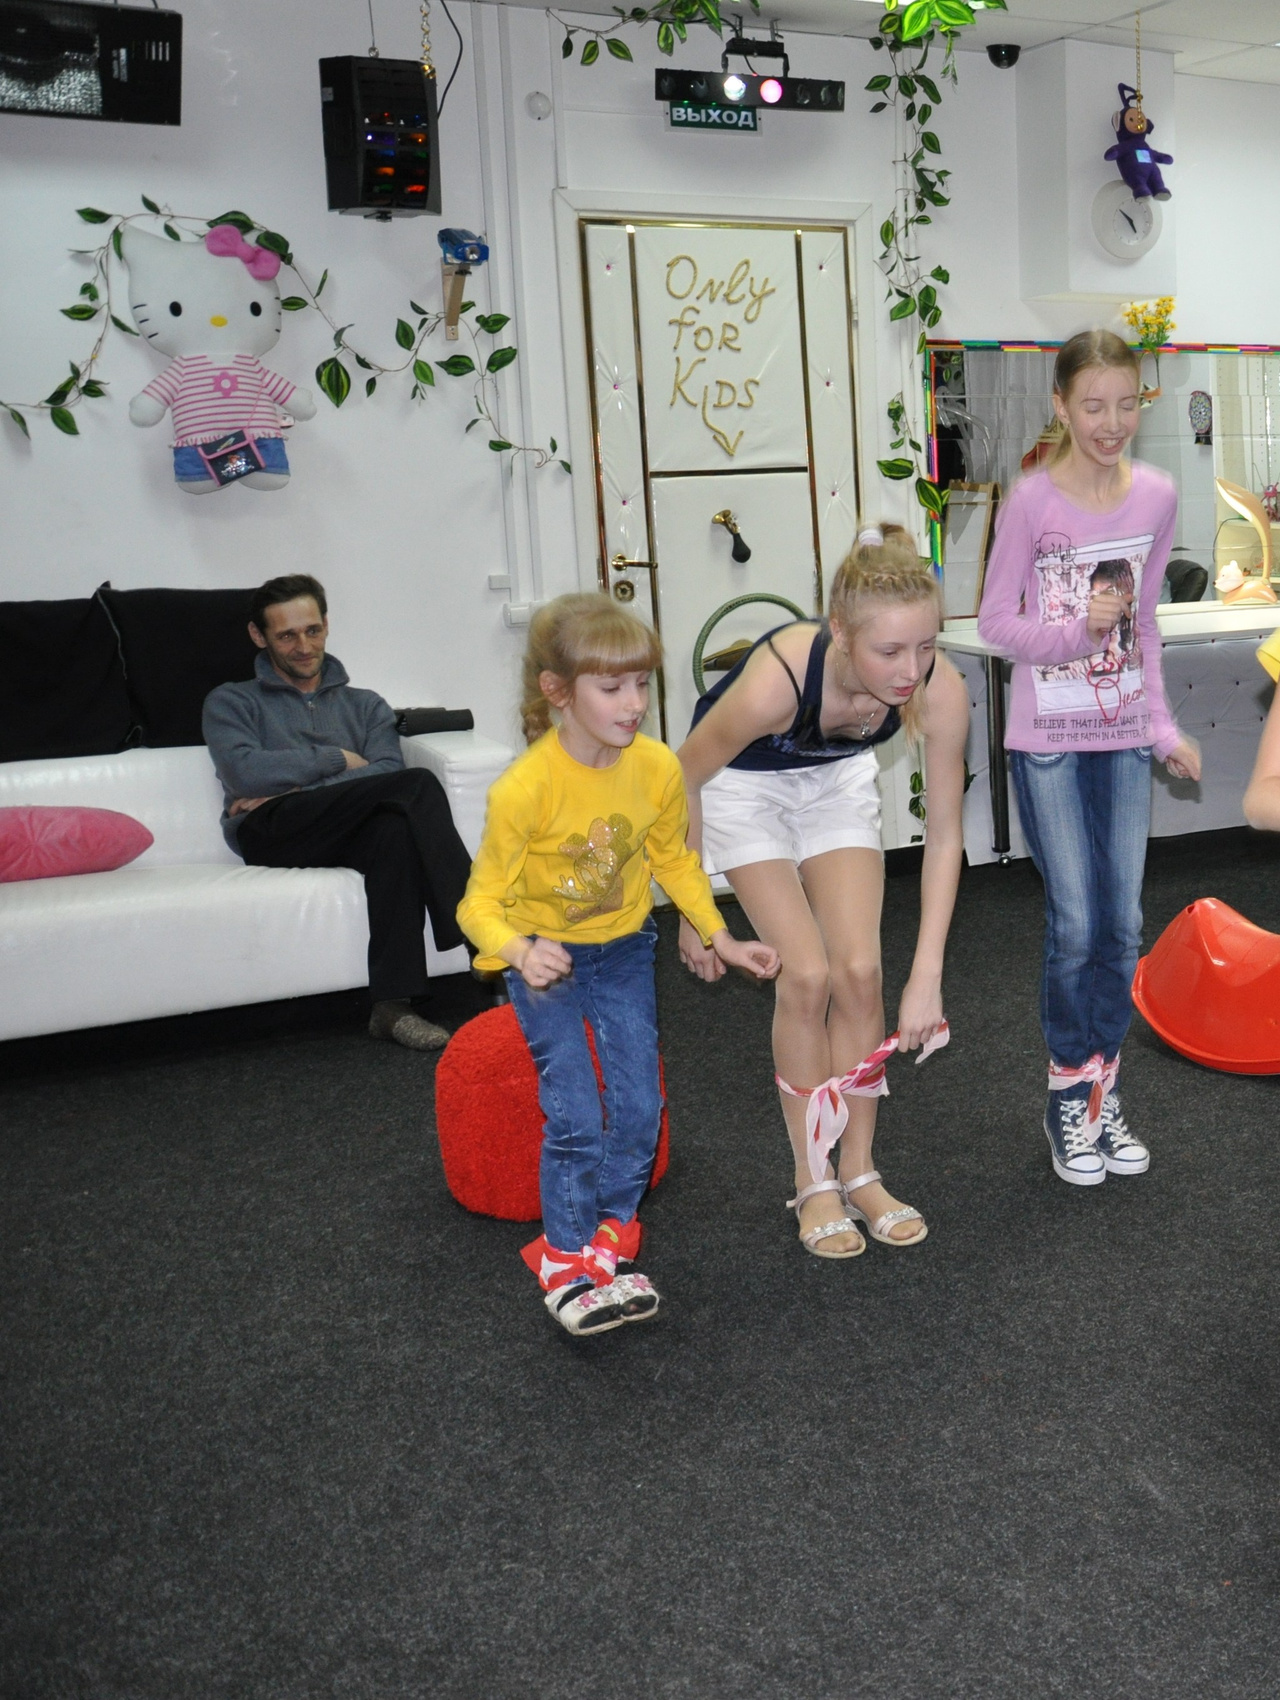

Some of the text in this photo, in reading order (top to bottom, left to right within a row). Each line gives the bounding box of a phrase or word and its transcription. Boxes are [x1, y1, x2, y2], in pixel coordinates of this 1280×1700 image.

[672, 107, 754, 128] ВЫХОД
[1033, 718, 1067, 729] BELIEVE
[1071, 719, 1093, 729] THAT
[1119, 715, 1139, 726] WANT
[1047, 732, 1065, 743] KEEP
[1066, 732, 1079, 742] THE
[1081, 731, 1100, 741] FAITH
[1102, 731, 1110, 741] IN
[1110, 731, 1117, 739] A
